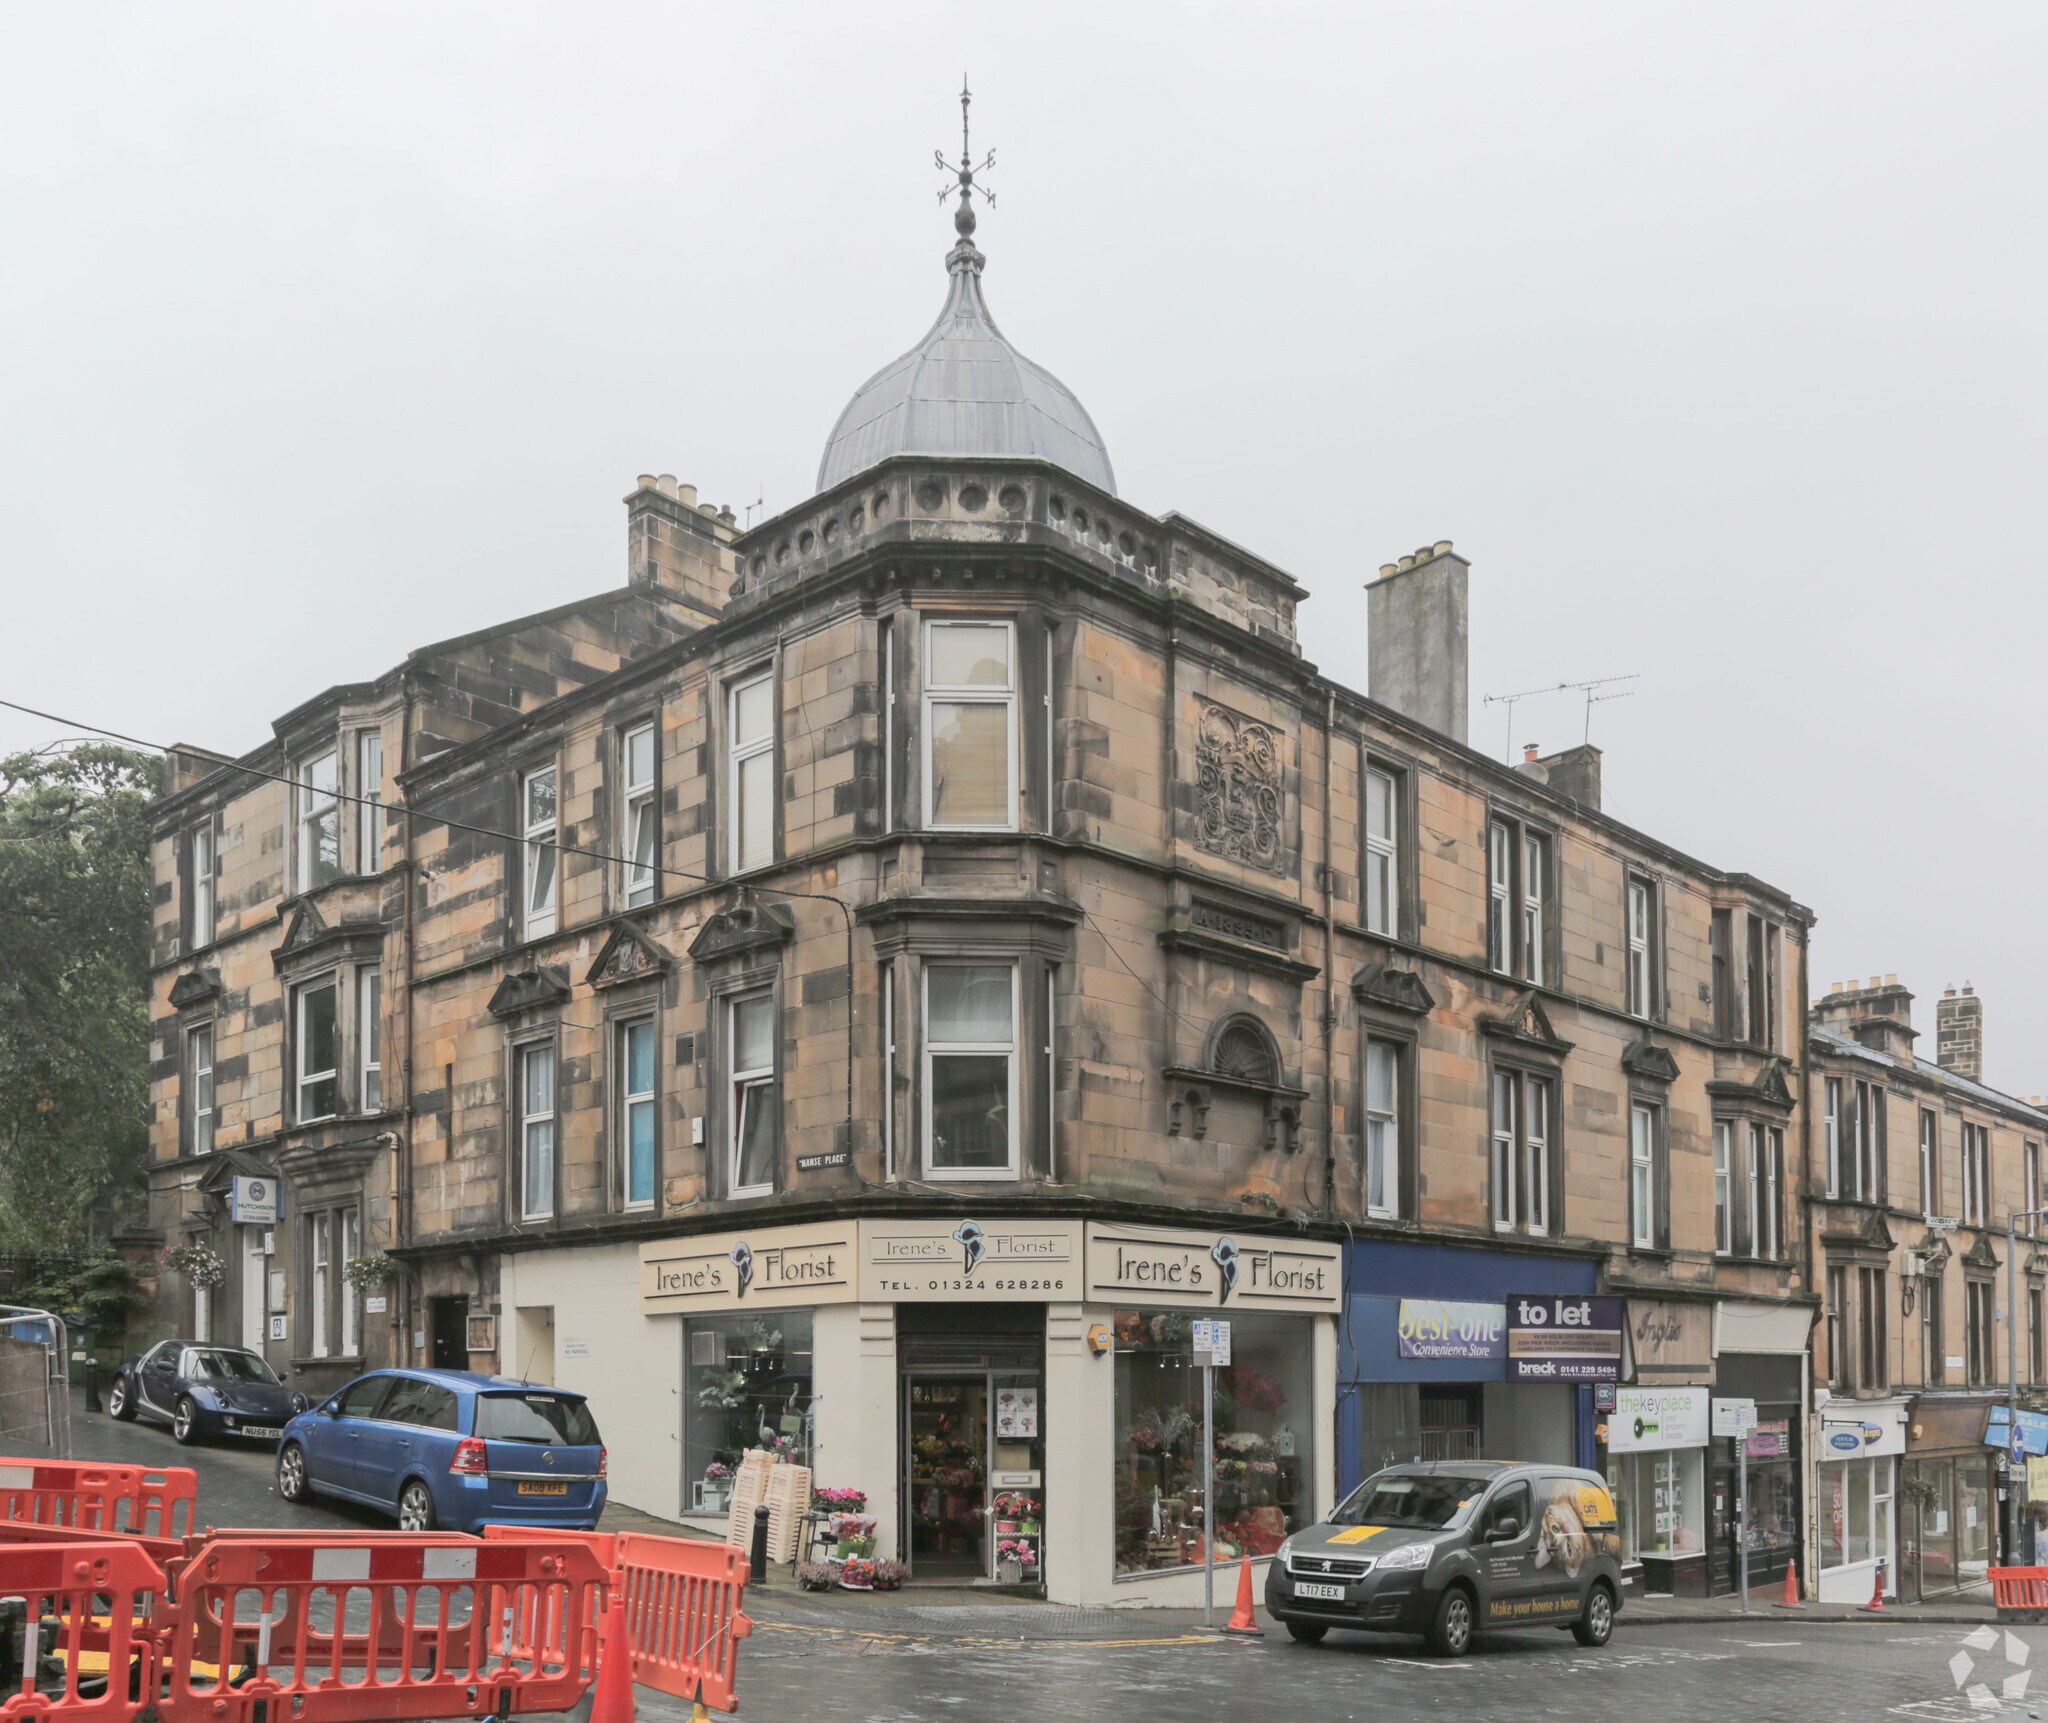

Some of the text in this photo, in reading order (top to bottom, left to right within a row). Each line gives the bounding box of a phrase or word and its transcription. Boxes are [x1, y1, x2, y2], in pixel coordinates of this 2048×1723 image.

[238, 1203, 275, 1211] HUTCHISON
[886, 1234, 1056, 1256] Irene's Florist
[657, 1247, 836, 1291] Irene's Florist
[1117, 1247, 1325, 1291] Irene's Florist
[880, 1280, 1064, 1290] TEL. 01324 628286
[1518, 1301, 1591, 1326] to let
[1399, 1303, 1501, 1342] best-one
[1412, 1342, 1490, 1357] Convenience Store
[1518, 1361, 1556, 1374] breck
[1620, 1394, 1692, 1415] thekeyplace
[2018, 1417, 2048, 1430] SALE
[245, 1427, 267, 1436] NU56
[521, 1482, 564, 1493] SA08 XFE
[1583, 1503, 1598, 1514] CATS
[1299, 1584, 1339, 1597] LT17 EEX
[1490, 1596, 1580, 1619] Make your house a home
